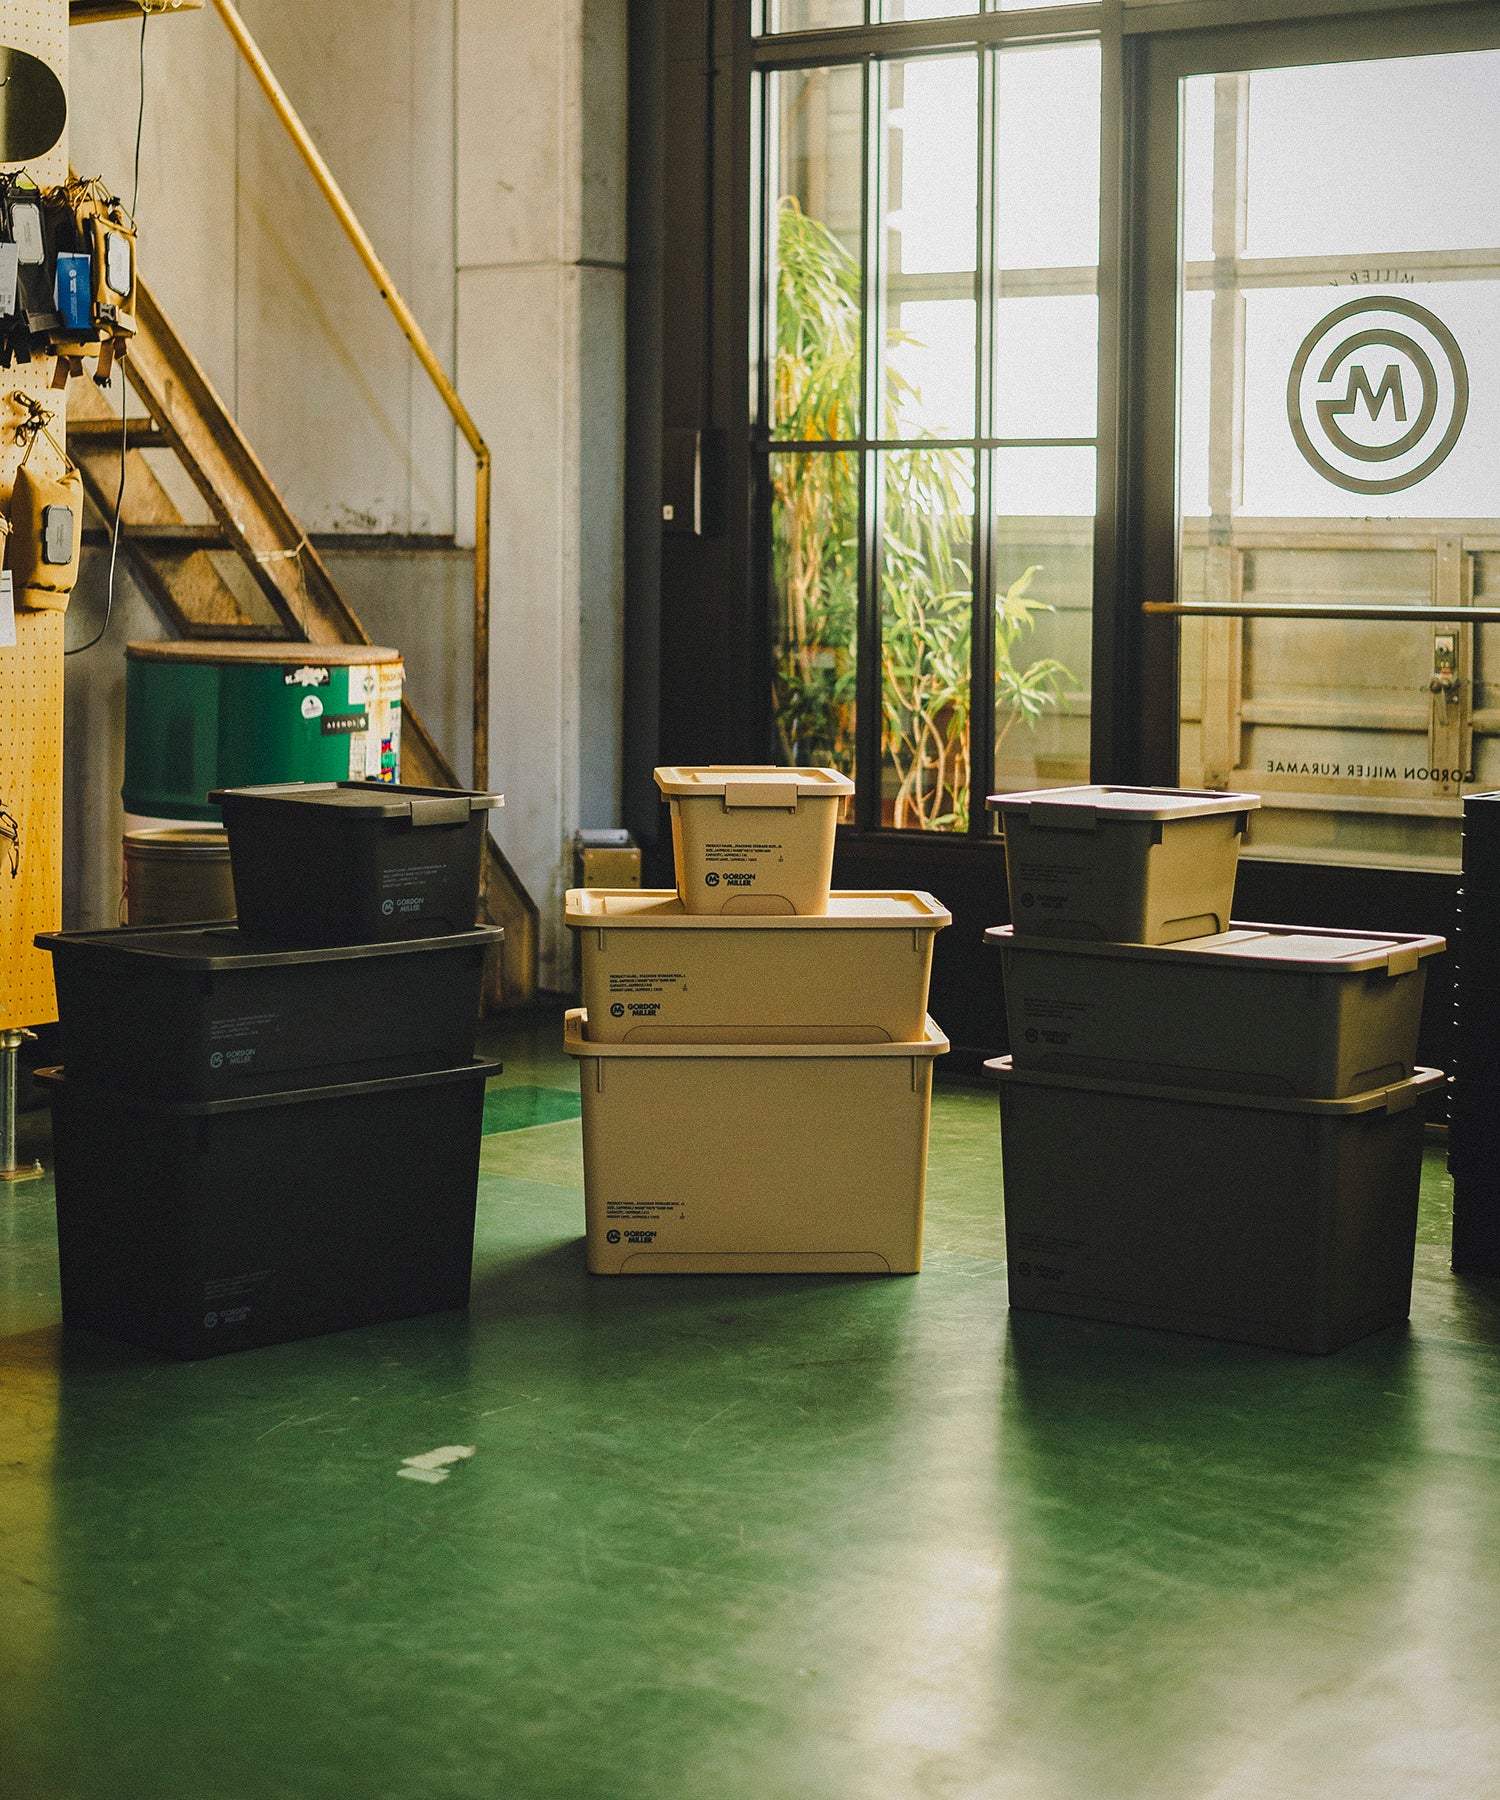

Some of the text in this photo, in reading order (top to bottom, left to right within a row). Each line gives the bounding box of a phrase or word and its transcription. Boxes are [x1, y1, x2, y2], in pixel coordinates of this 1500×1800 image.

[396, 897, 425, 906] GORDON
[632, 1009, 657, 1017] MILLER
[226, 1048, 256, 1058] GORDON
[230, 1055, 251, 1065] MILLER
